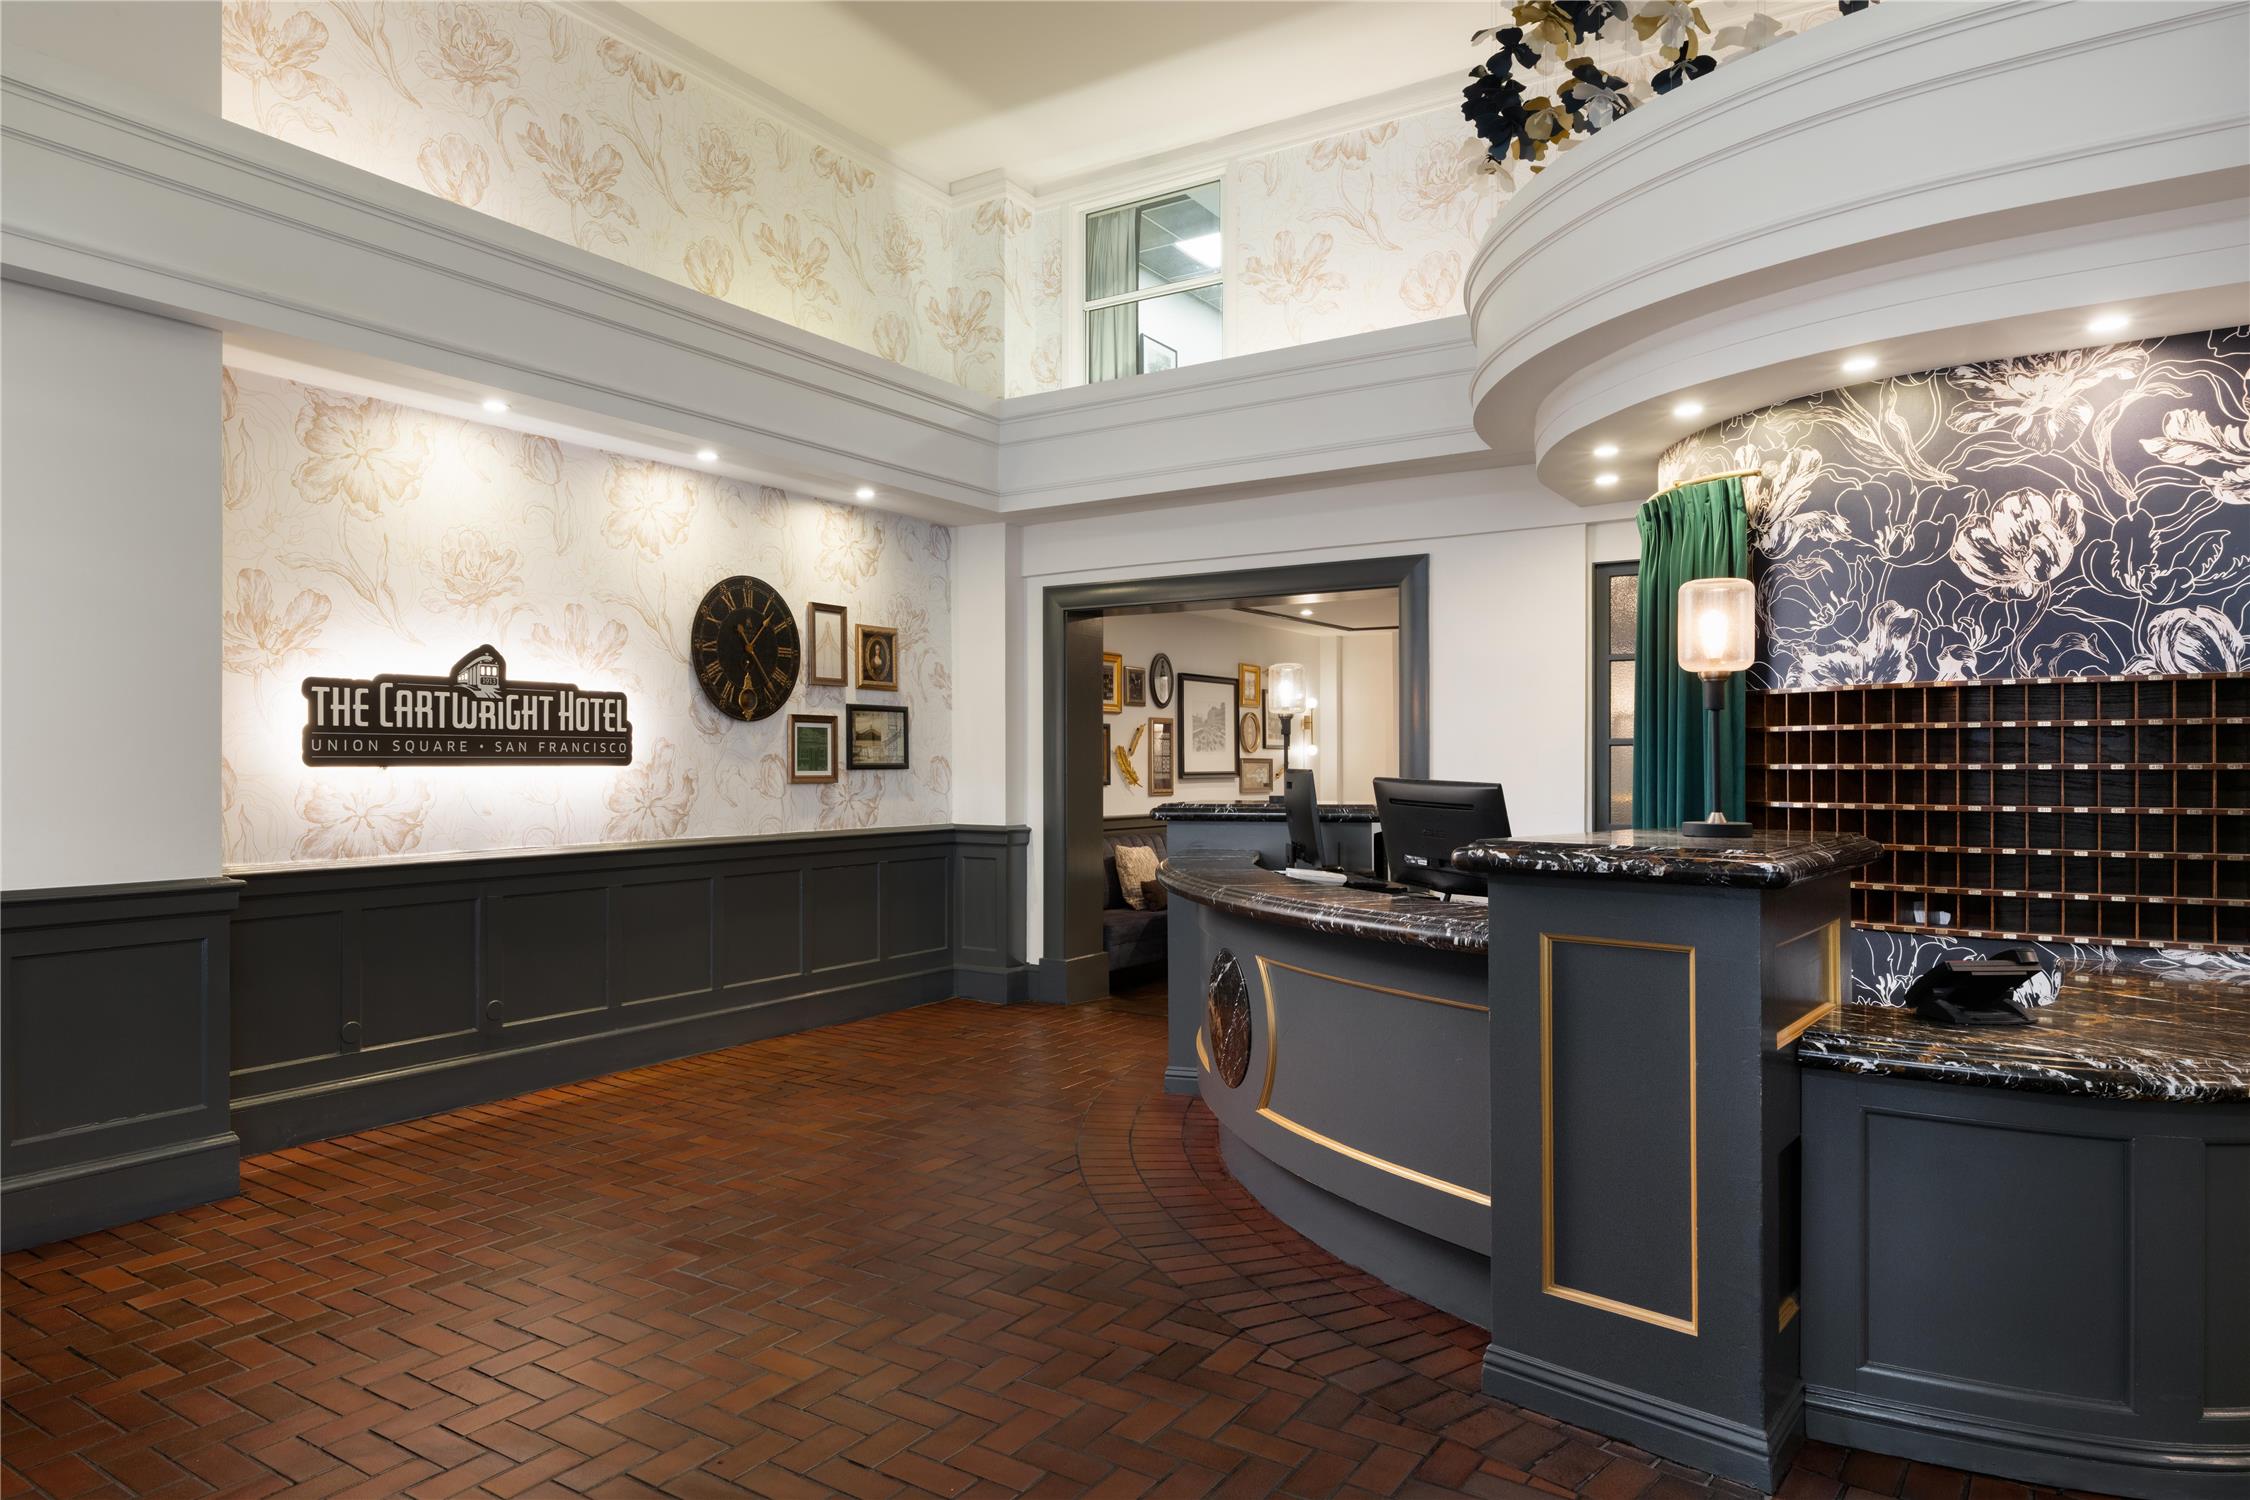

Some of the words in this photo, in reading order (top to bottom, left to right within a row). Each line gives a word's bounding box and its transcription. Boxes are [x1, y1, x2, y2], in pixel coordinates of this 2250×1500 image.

[482, 677, 497, 685] 1913
[311, 686, 369, 727] THE
[379, 682, 554, 731] CARTWRIGHT
[558, 690, 627, 732] HOTEL
[311, 739, 378, 752] UNION
[392, 739, 468, 754] SQUARE
[494, 741, 527, 753] SAN
[538, 741, 627, 753] FRANCISCO
